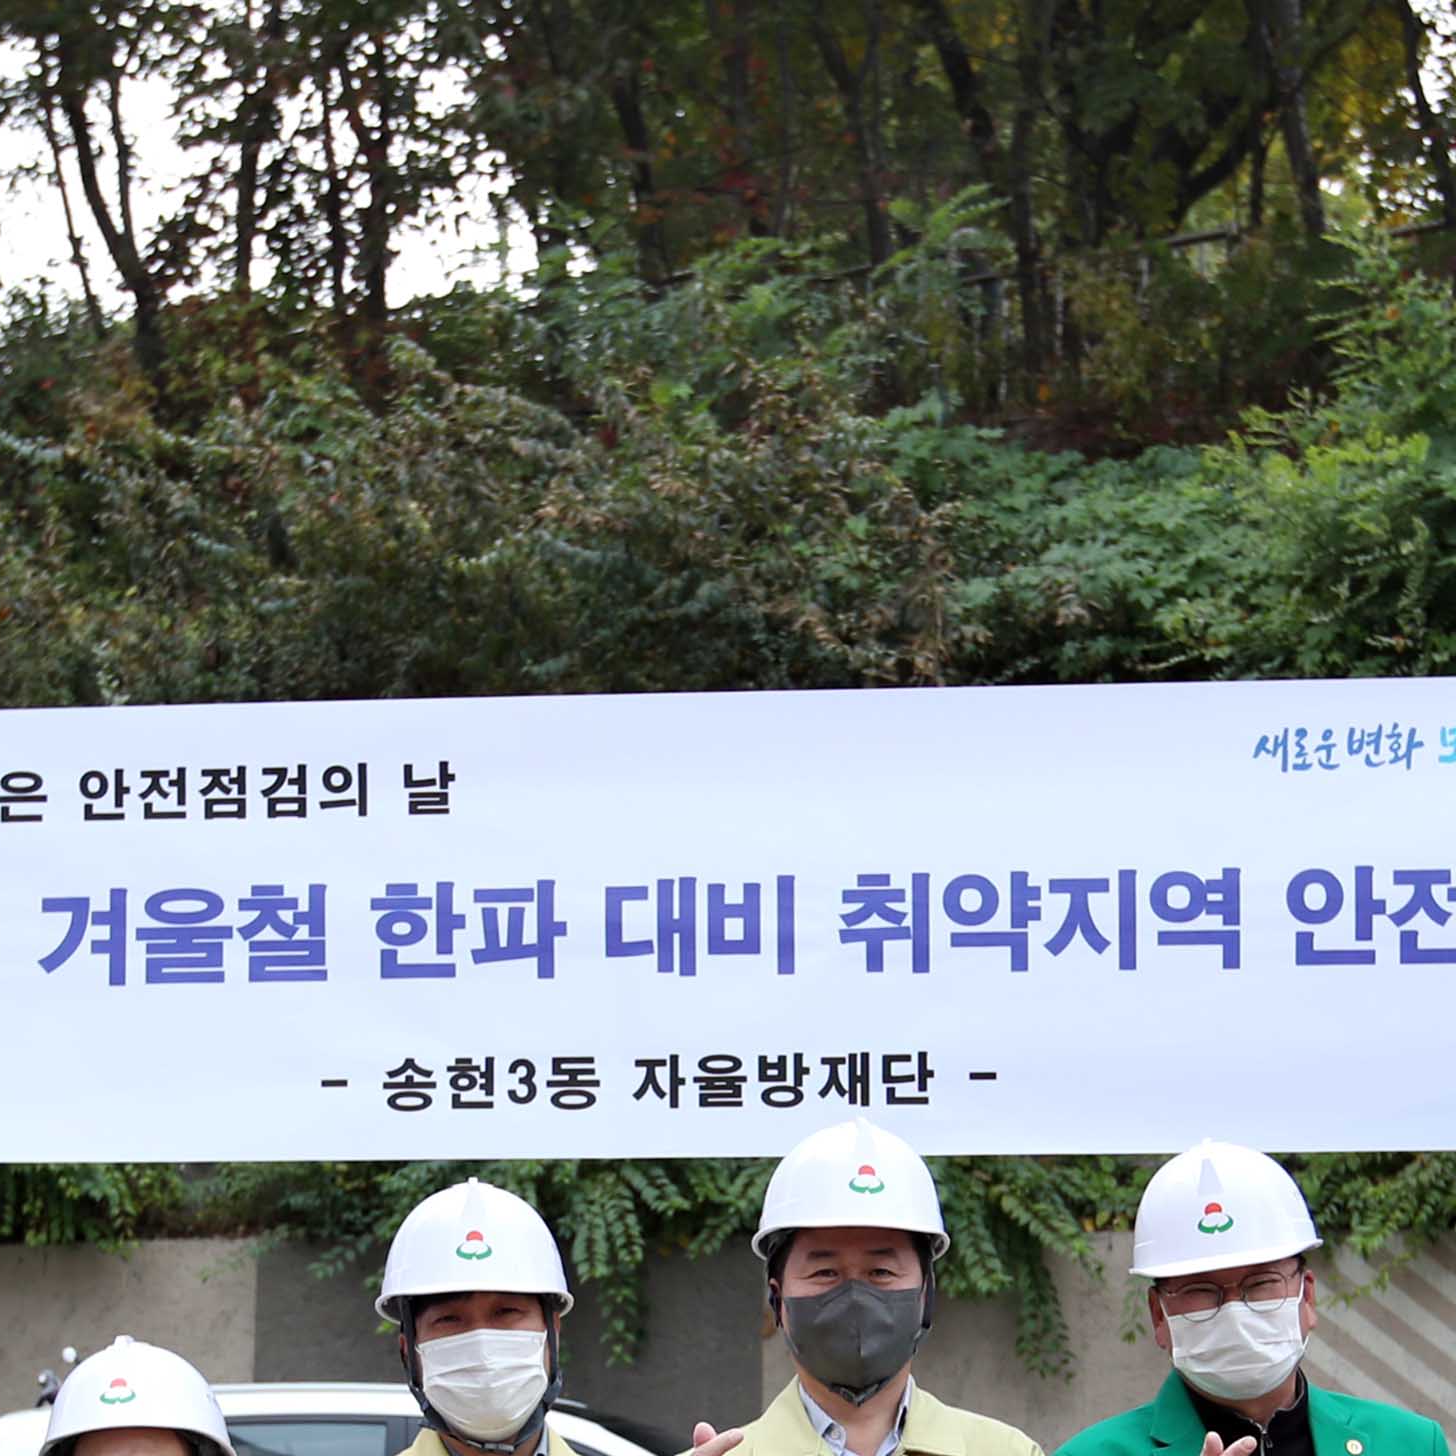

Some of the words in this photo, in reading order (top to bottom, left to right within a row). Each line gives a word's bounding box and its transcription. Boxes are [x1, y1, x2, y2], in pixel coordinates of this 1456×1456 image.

[1252, 726, 1341, 774] 새로운
[1346, 721, 1425, 772] 변화
[78, 761, 369, 823] 안전점검의
[402, 759, 457, 816] 날
[36, 883, 329, 988] 겨울철
[369, 878, 569, 980] 한파
[604, 874, 796, 978] 대비
[837, 866, 1242, 975] 취약지역
[381, 1055, 602, 1113] 송현3동
[631, 1050, 936, 1110] 자율방재단
